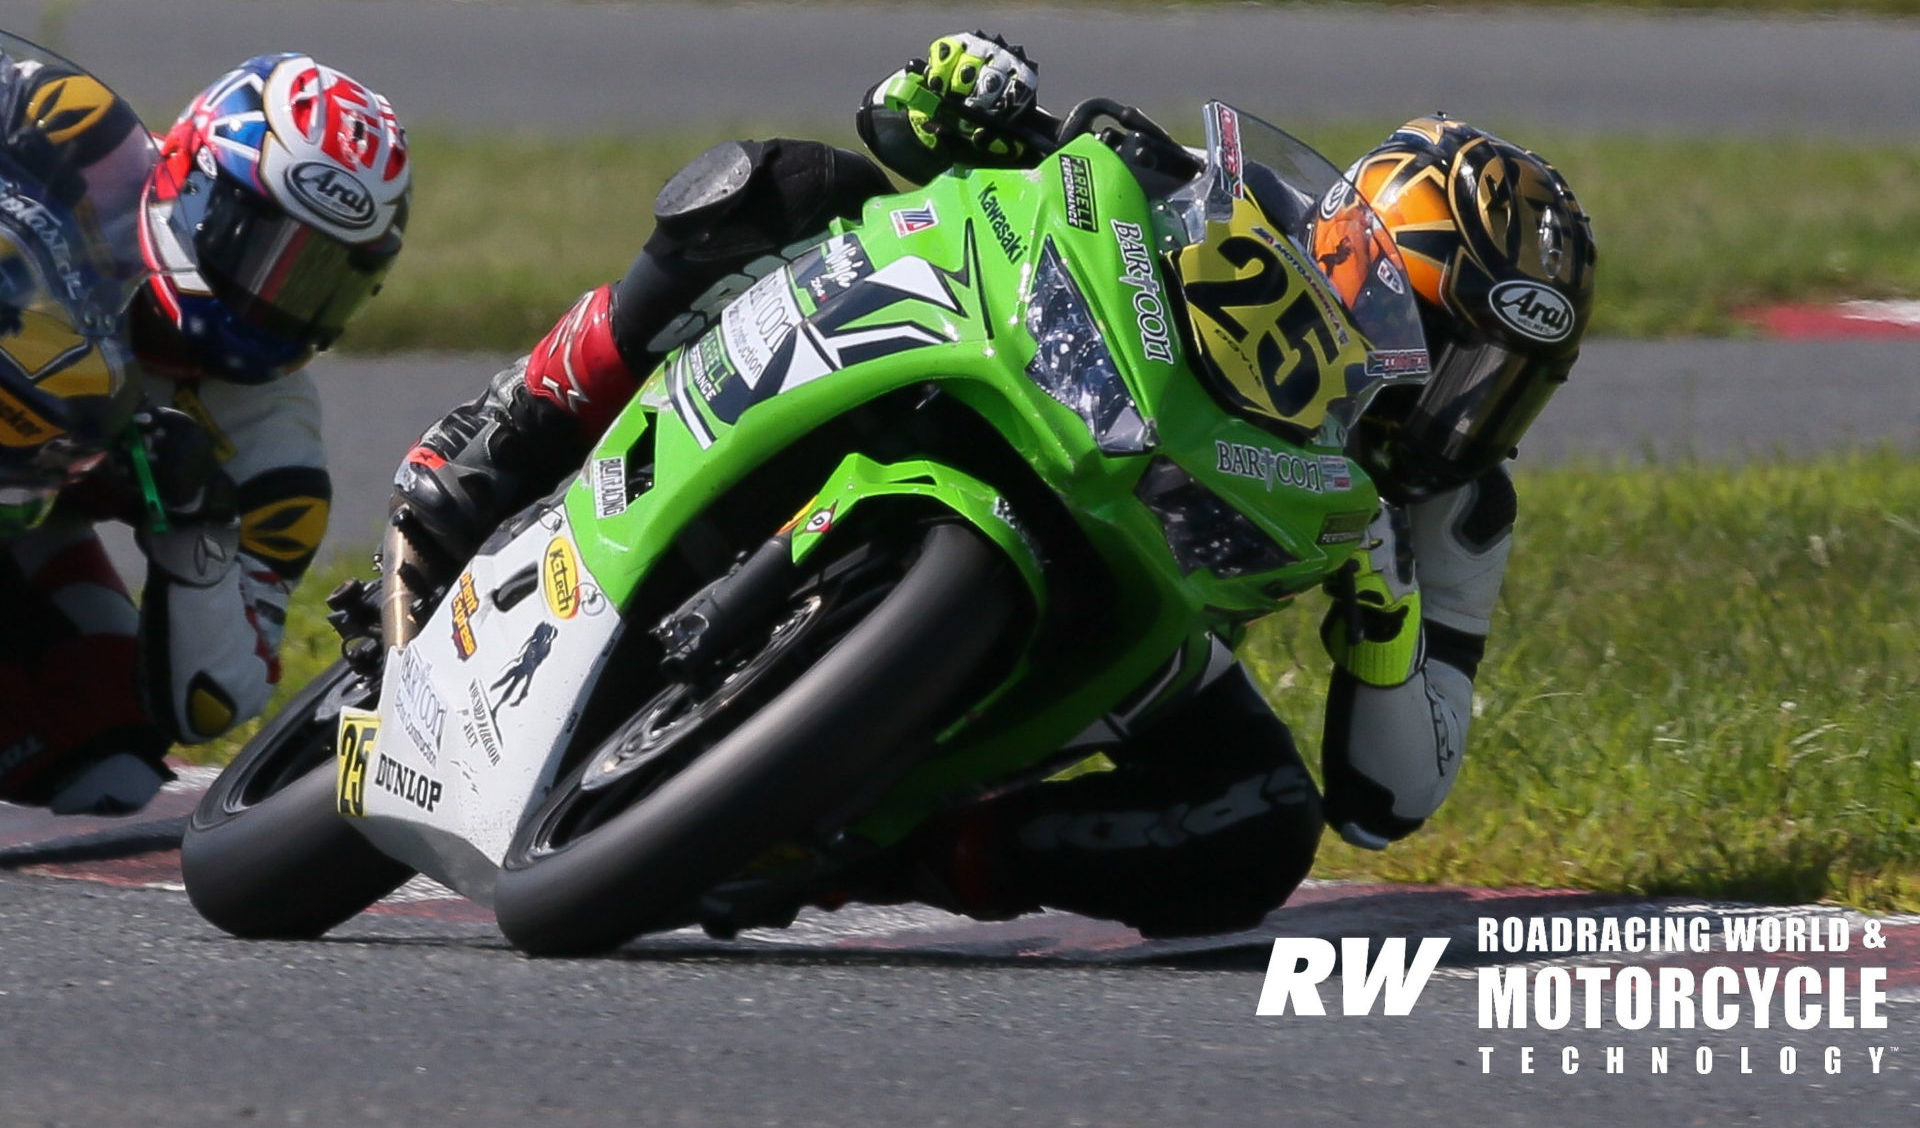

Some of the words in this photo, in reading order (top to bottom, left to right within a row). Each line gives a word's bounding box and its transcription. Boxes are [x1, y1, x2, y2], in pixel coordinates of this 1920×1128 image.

[300, 169, 370, 214] Arai
[978, 181, 1028, 265] Kawasaki
[1062, 156, 1078, 227] PERFORMANCE
[1071, 157, 1092, 231] FARRELL
[1185, 236, 1339, 417] 25
[1500, 289, 1568, 330] Arai
[340, 724, 377, 816] 25
[375, 753, 442, 812] DUNLOP
